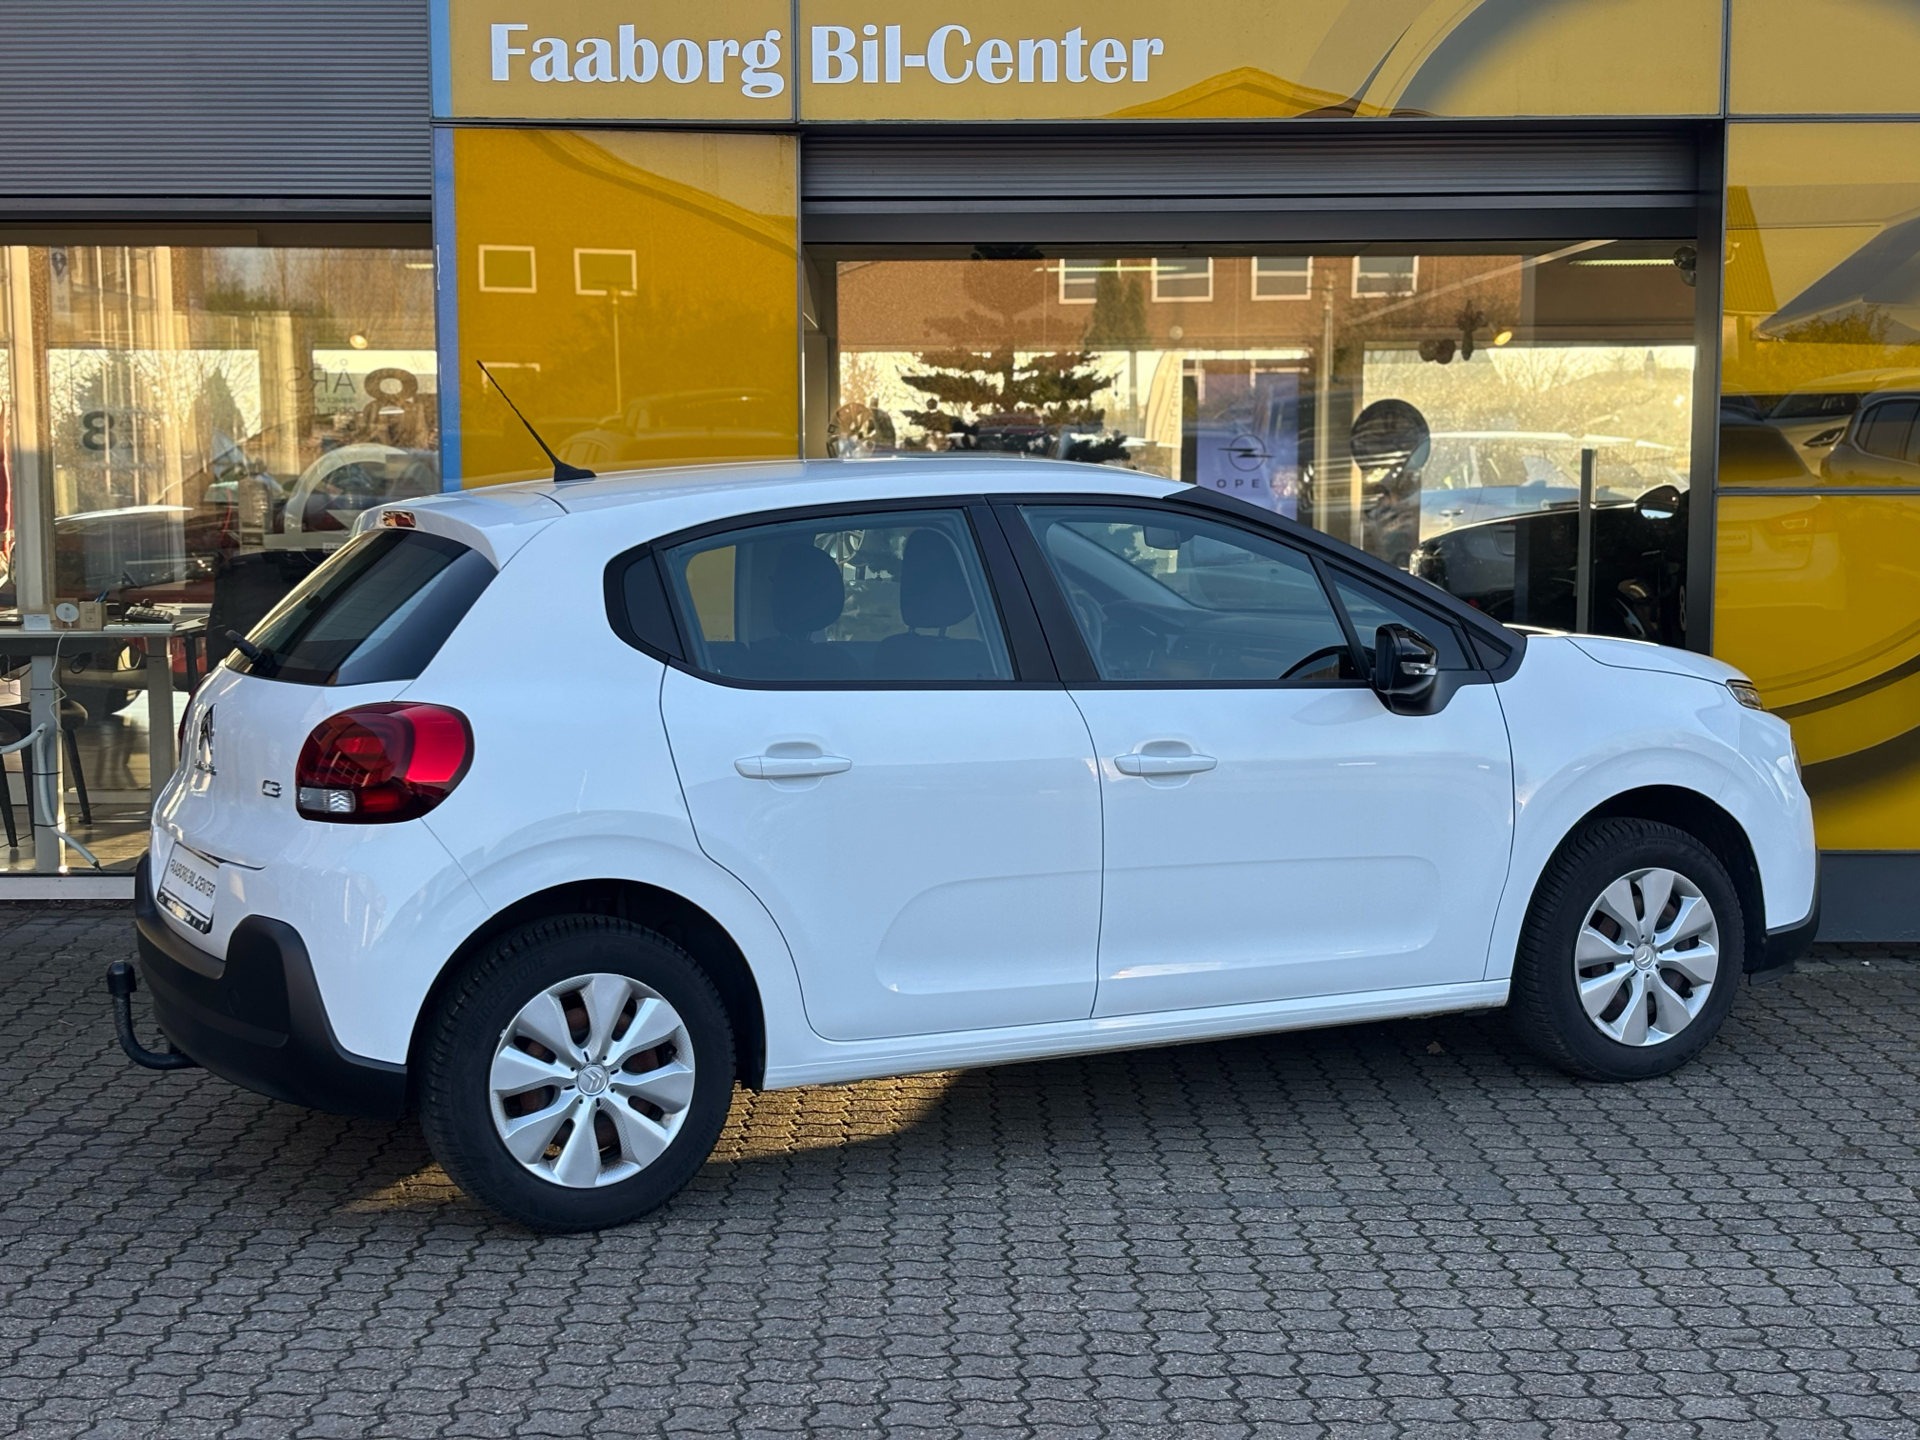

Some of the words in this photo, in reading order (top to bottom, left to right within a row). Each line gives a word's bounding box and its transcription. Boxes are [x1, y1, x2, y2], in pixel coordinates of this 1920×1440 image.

[490, 23, 785, 99] Faaborg
[811, 24, 1164, 84] Bil-Center
[1216, 478, 1276, 489] OPEL
[186, 870, 216, 898] BIL-CENTER
[466, 954, 548, 1047] BRIDGESTONE
